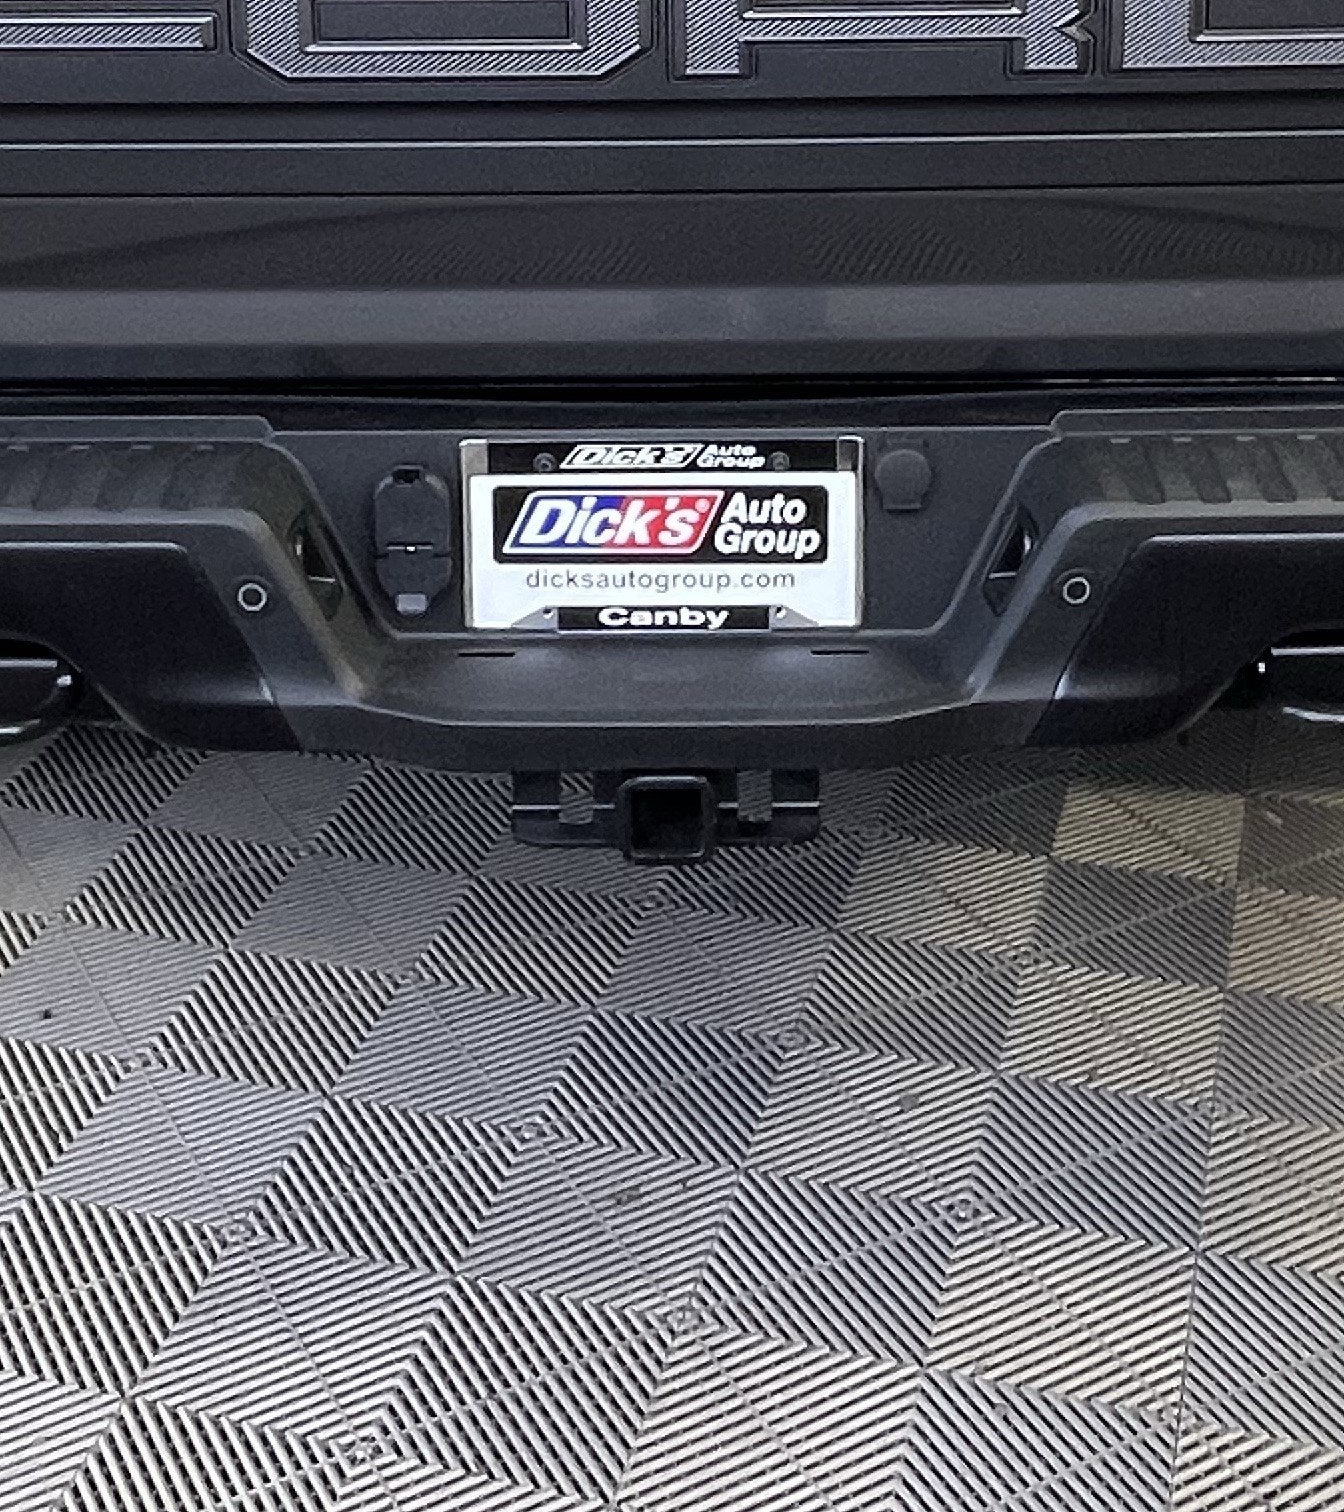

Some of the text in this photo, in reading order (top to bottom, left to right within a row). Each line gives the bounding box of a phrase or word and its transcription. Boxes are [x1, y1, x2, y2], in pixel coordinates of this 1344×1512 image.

[571, 444, 757, 465] Dick's Auto
[696, 455, 766, 469] Group
[519, 492, 808, 545] Dick's Auto
[713, 524, 822, 559] Group
[525, 568, 796, 594] dicksautogroup.com
[598, 607, 730, 630] Canby
